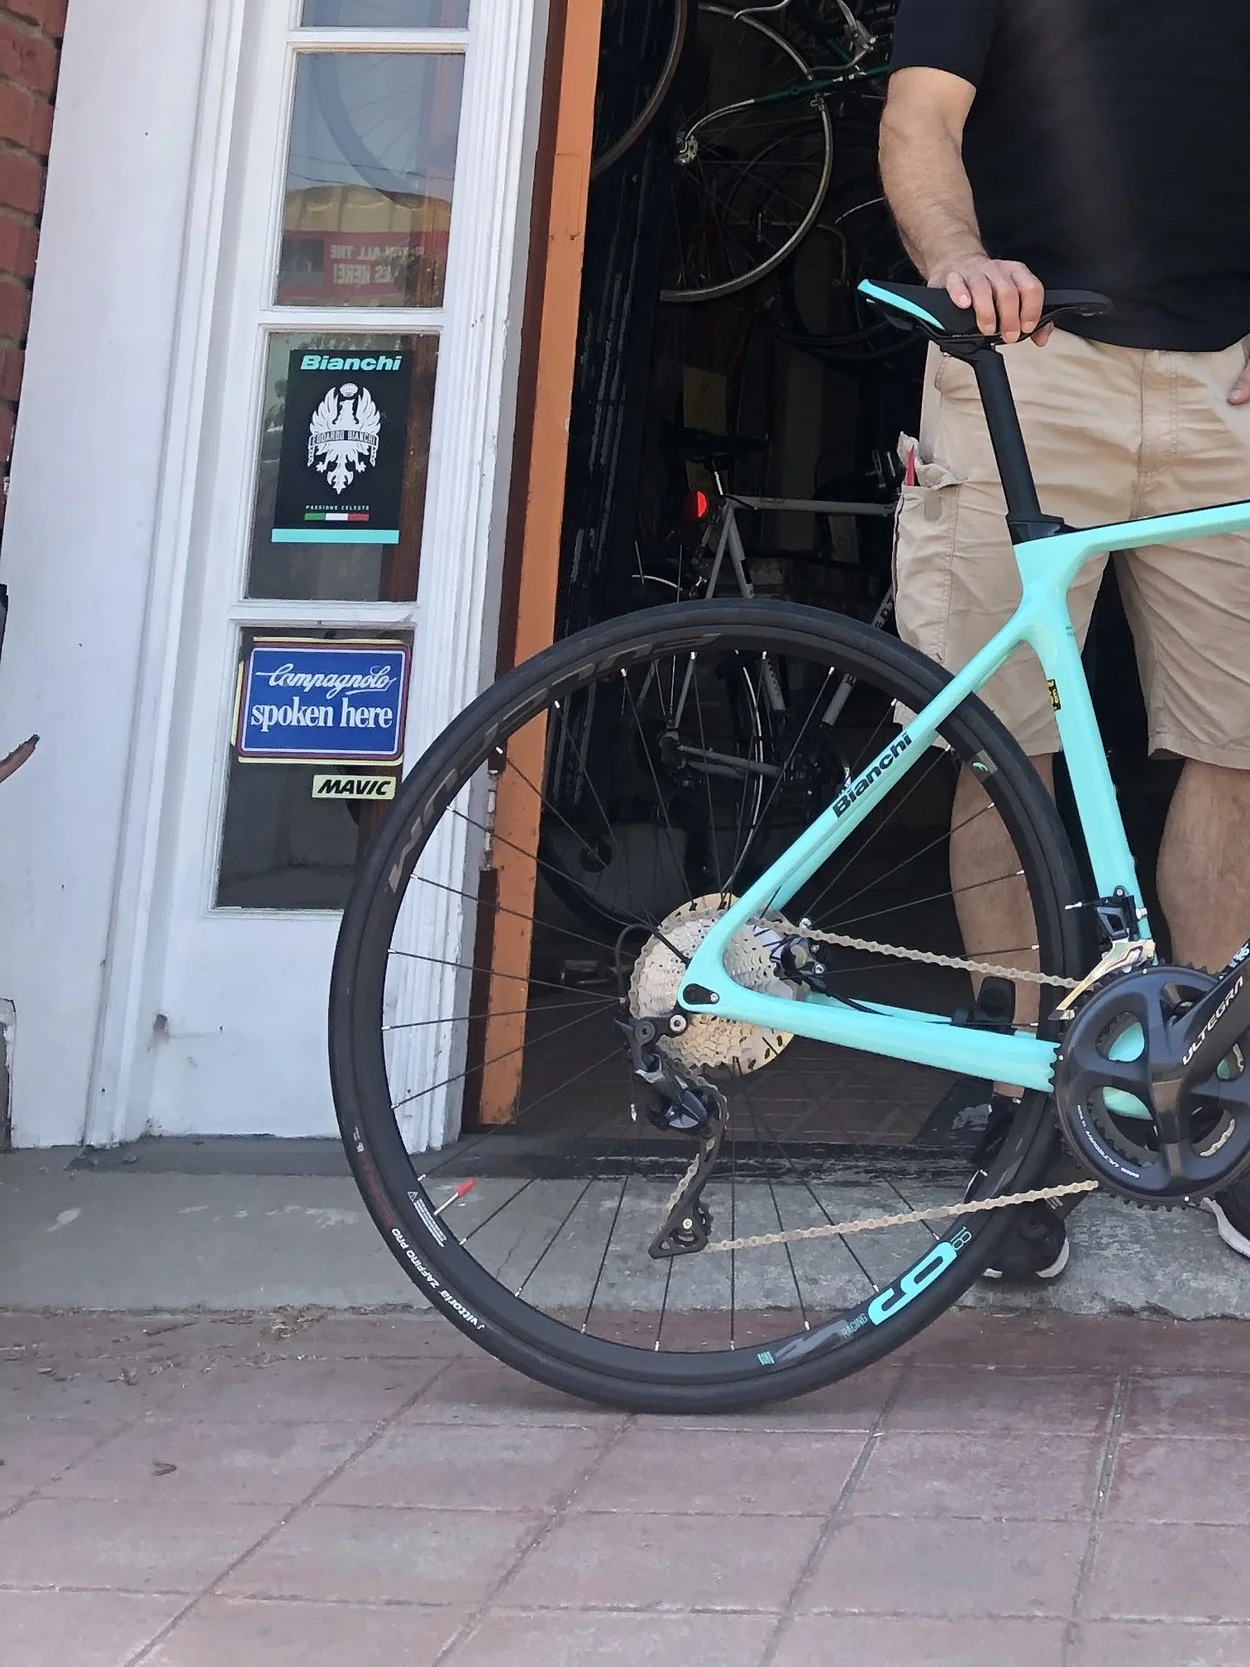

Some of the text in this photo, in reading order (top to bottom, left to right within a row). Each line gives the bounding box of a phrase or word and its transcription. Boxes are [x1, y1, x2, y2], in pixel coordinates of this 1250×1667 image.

[300, 355, 402, 371] Bianchi
[347, 430, 376, 445] BIANCHI
[255, 663, 397, 699] Campagnolo
[250, 696, 393, 732] spoken here
[317, 779, 391, 796] MAVIC
[832, 732, 912, 818] Bianchi
[1182, 976, 1244, 1066] ULTEGRA
[391, 1228, 410, 1250] PRO
[405, 1250, 440, 1288] ZAFFIRO
[439, 1289, 479, 1326] vittoria
[841, 1312, 868, 1338] RACING
